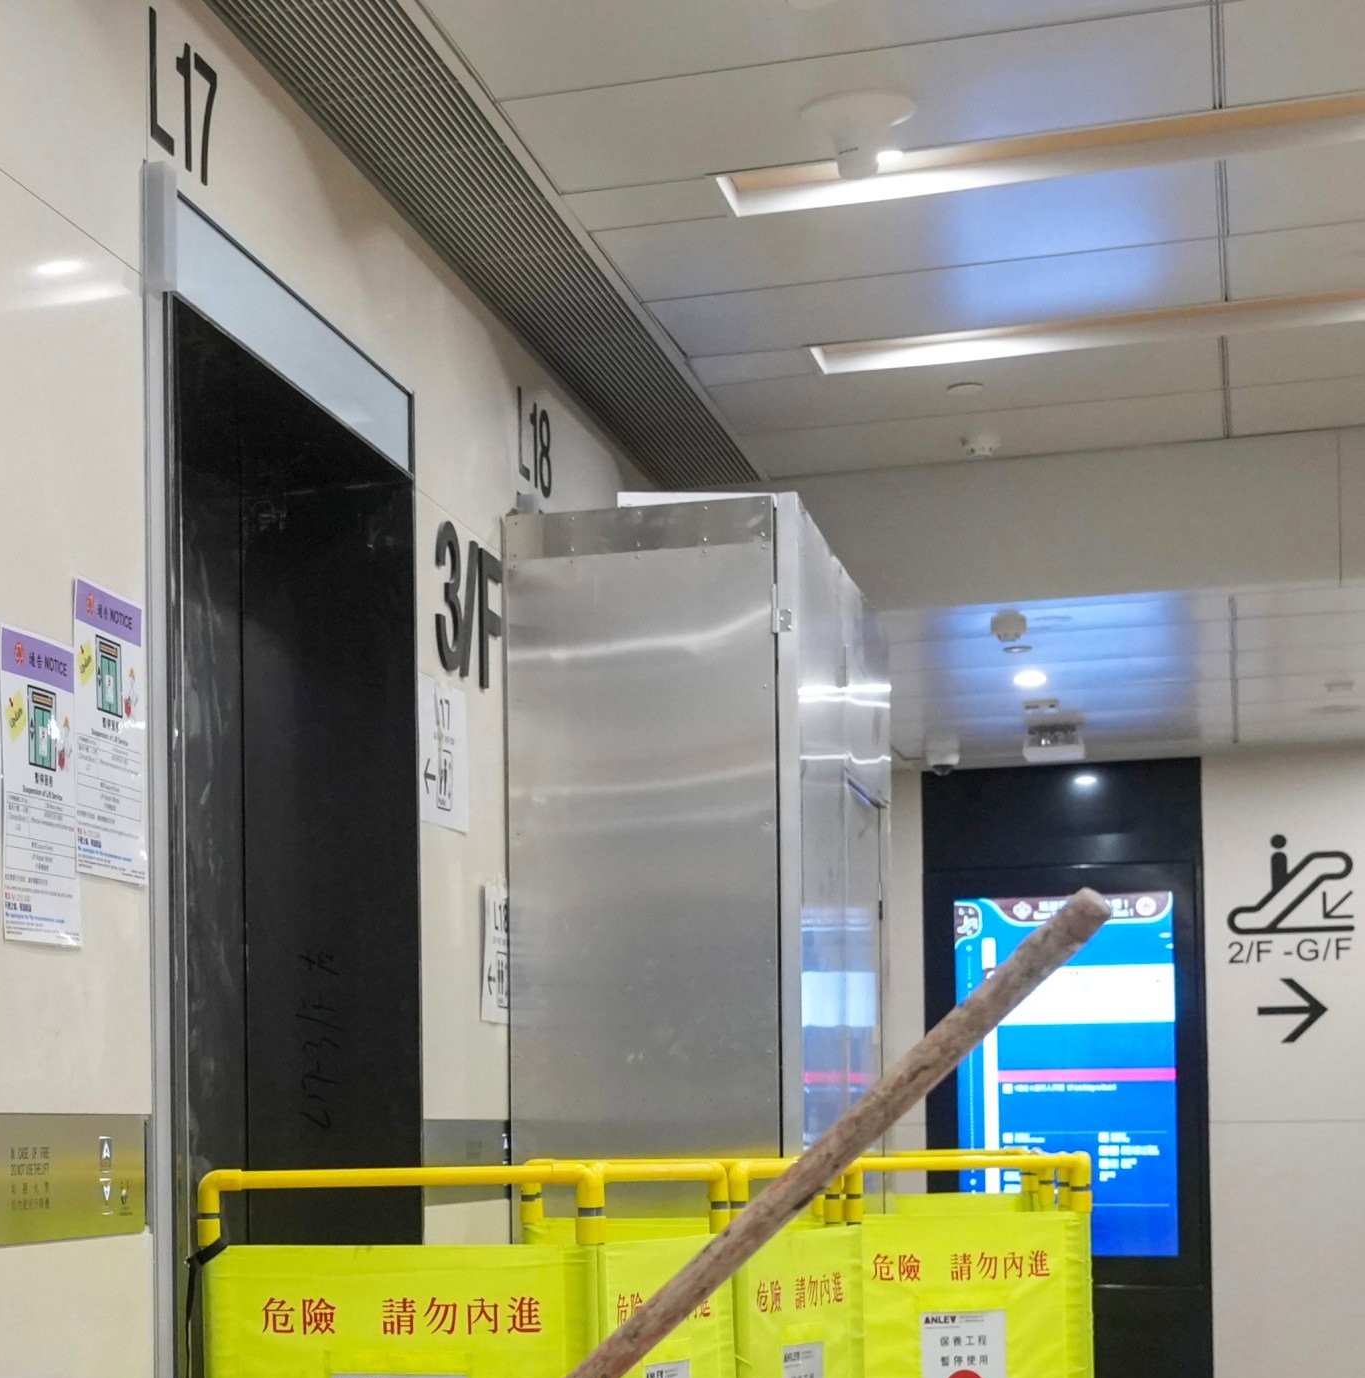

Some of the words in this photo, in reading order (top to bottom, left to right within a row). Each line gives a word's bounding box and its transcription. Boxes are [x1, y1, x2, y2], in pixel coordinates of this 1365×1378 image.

[149, 6, 218, 187] L17
[517, 386, 552, 499] L18
[110, 609, 133, 631] NOTICE
[435, 520, 503, 691] 3/F
[45, 655, 68, 677] NOTICE
[1228, 941, 1273, 964] 2/F
[872, 1253, 921, 1282] 危險
[951, 1250, 1050, 1280] 請勿內進
[757, 1279, 782, 1313] 危險
[795, 1272, 843, 1310] 請勿內進
[262, 1297, 336, 1336] 危險
[382, 1296, 543, 1336] 請勿內進
[924, 1315, 957, 1325] ANLEV
